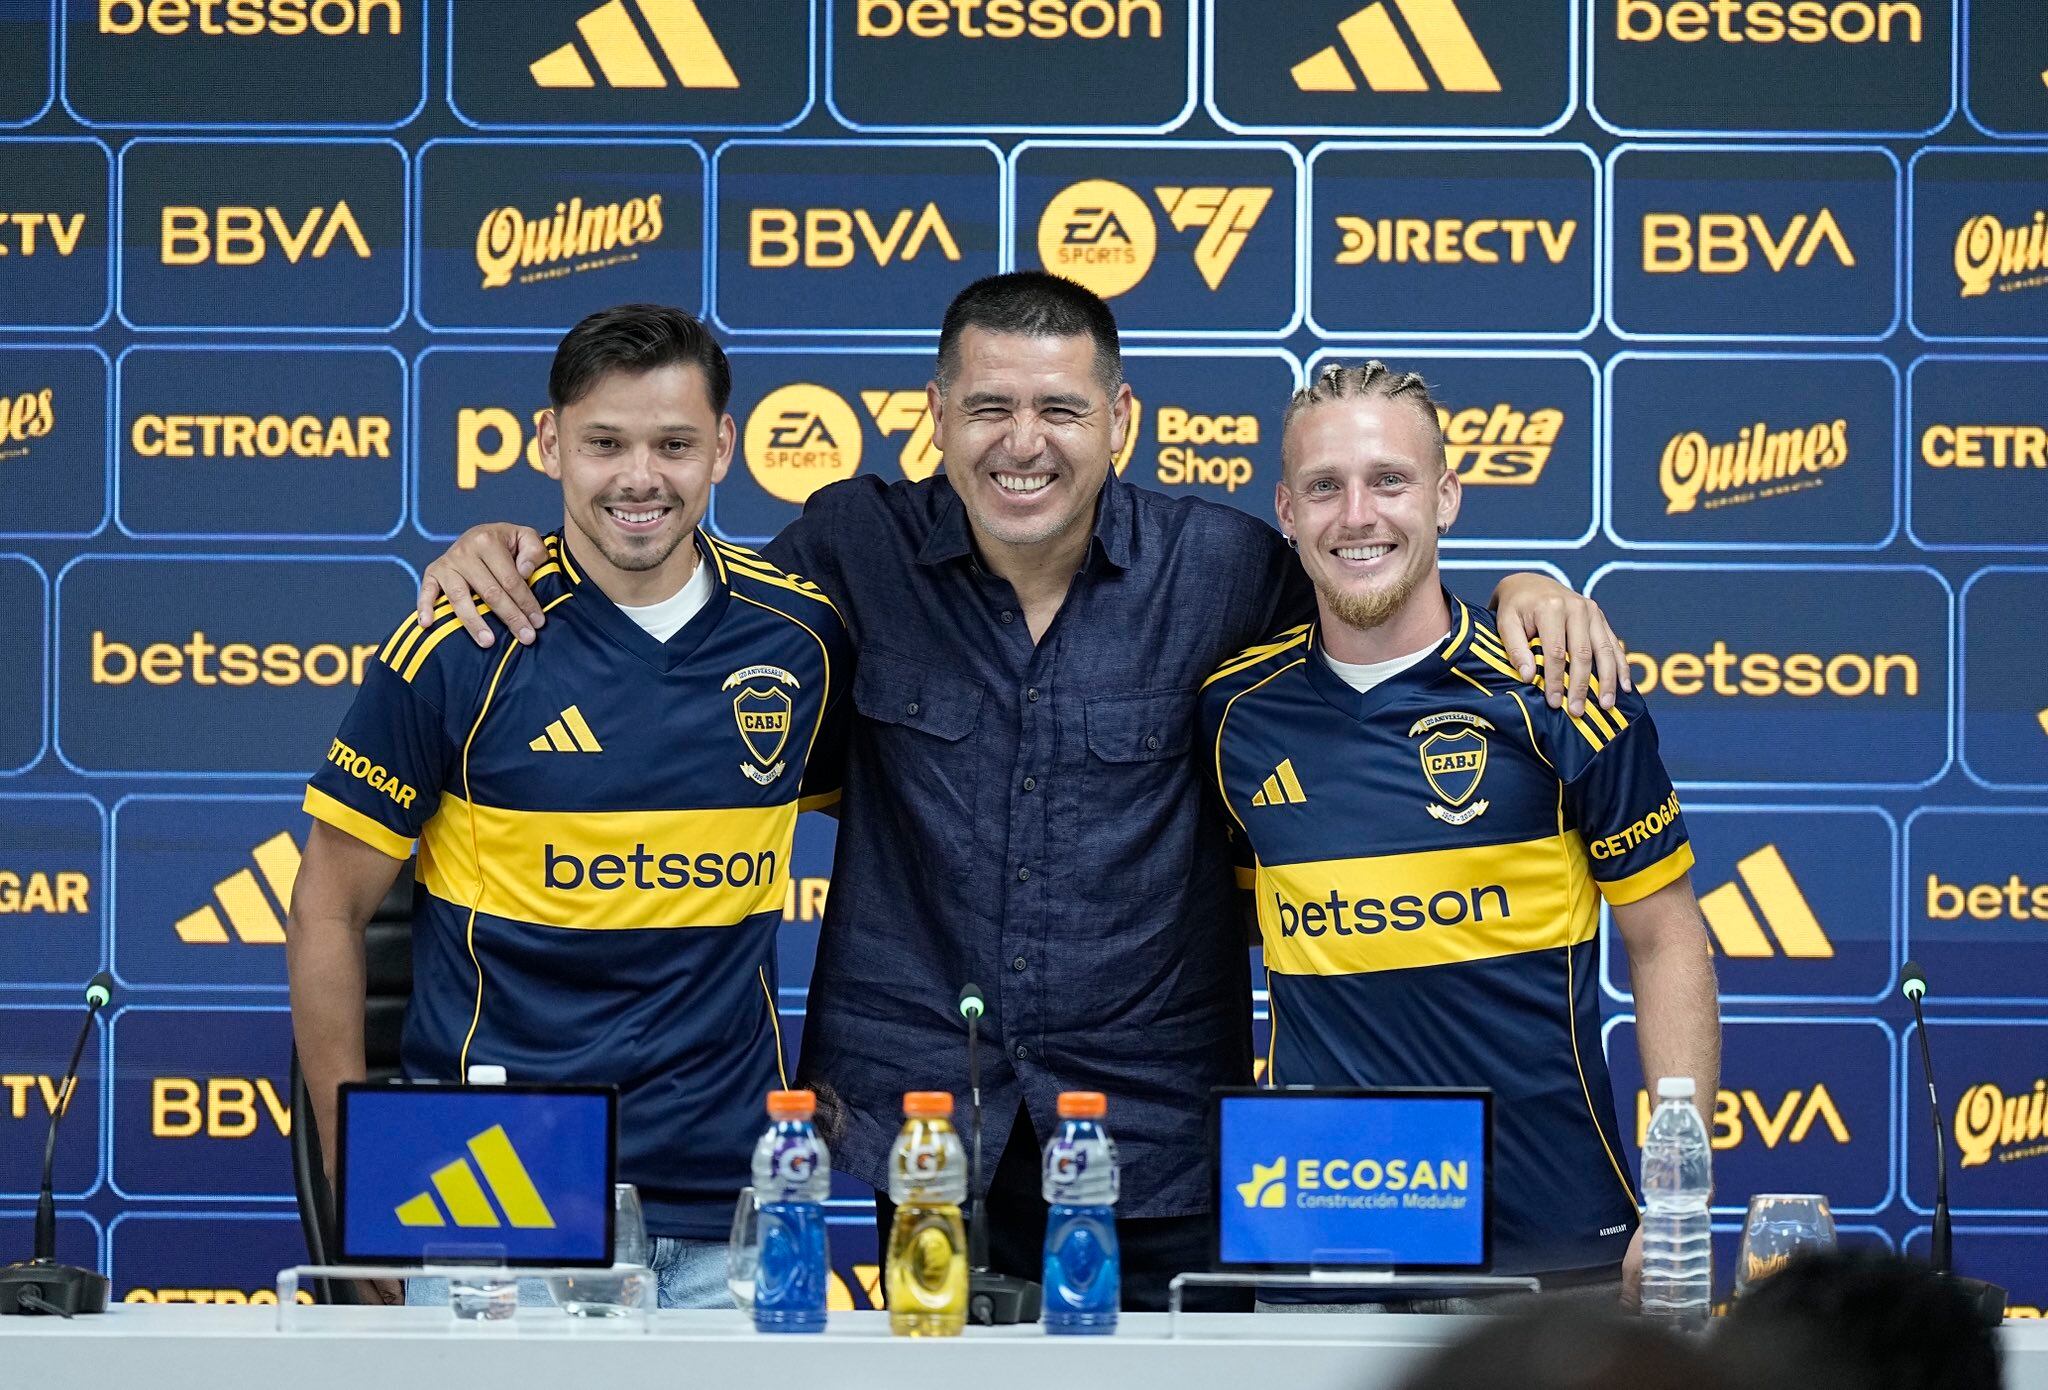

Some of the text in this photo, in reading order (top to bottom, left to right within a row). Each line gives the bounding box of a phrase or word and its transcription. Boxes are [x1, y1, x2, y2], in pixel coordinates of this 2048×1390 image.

[99, 0, 402, 36] betsson
[857, 0, 1163, 39] betsson
[1616, 0, 1923, 43] betsson
[161, 201, 372, 265] BBVA
[476, 193, 664, 289] Quilmes
[749, 203, 962, 268] BBVA
[1062, 207, 1132, 245] EA
[1335, 216, 1578, 266] DIRECTV
[1643, 209, 1856, 273] BBVA
[1058, 247, 1137, 265] SPORTS
[1954, 211, 2048, 298] Qui
[132, 415, 392, 458] CETROGAR
[768, 411, 839, 449] EA
[1157, 407, 1260, 444] Boca
[763, 451, 843, 469] SPORTS
[1157, 446, 1254, 493] Shop
[1659, 419, 1849, 515] Quilmes
[744, 715, 783, 730] CABJ
[326, 737, 417, 810] TROGAR
[1431, 753, 1477, 771] CABJ
[543, 843, 776, 891] betsson
[1275, 883, 1511, 938] betsson
[152, 1078, 292, 1138] BBV
[1955, 1080, 2048, 1168] Qui
[1296, 1158, 1468, 1191] ECOSAN
[1296, 1191, 1467, 1210] Construcción Modular
